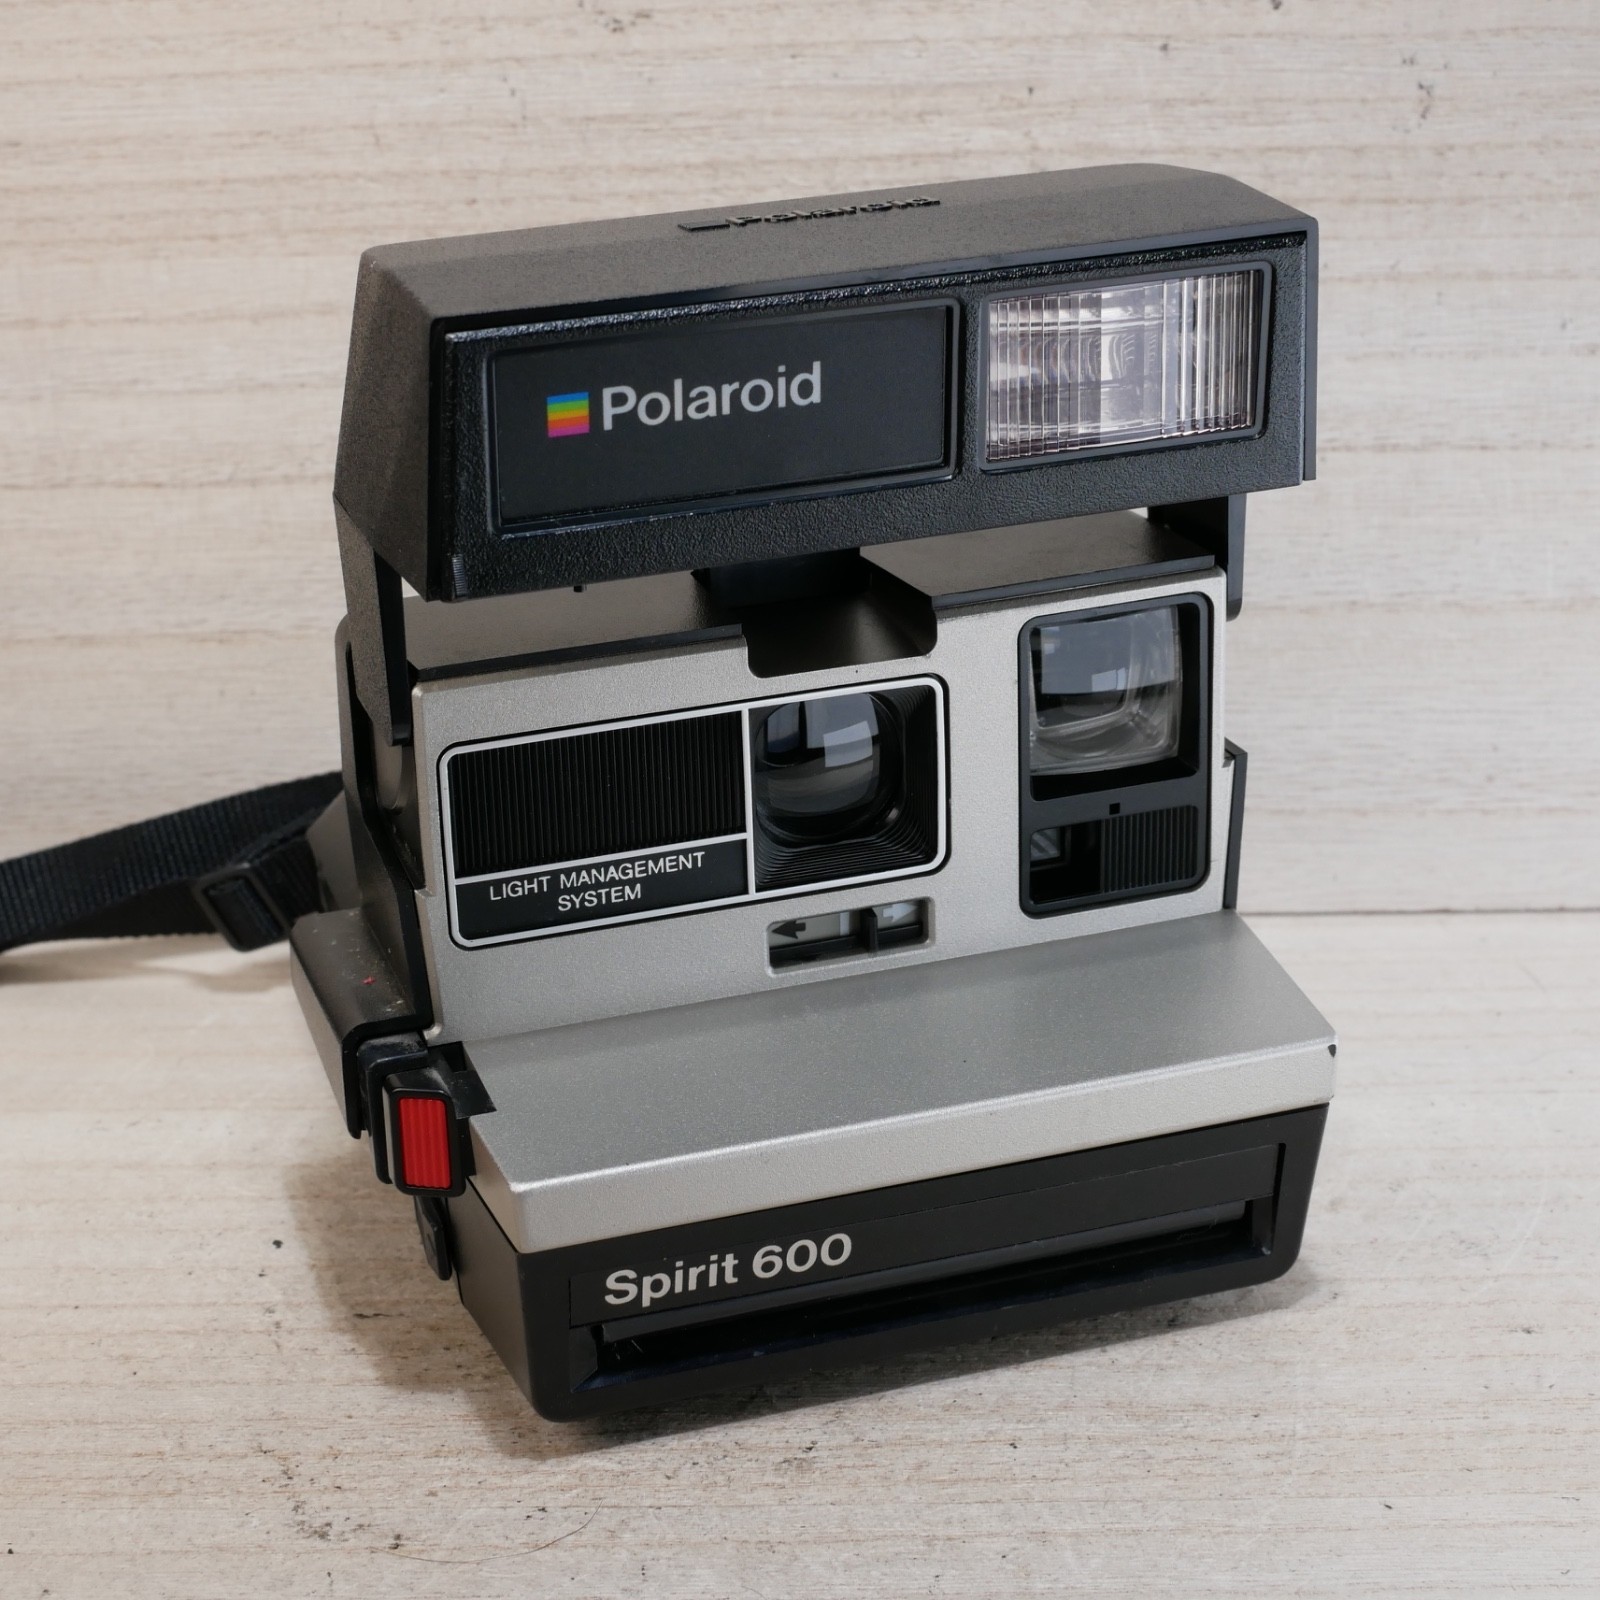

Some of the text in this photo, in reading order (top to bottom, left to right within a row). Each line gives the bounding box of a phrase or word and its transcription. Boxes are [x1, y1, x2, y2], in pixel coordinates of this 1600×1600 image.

[725, 195, 941, 226] Polaroid
[602, 361, 821, 431] Polaroid
[489, 851, 705, 901] LIGHT MANAGEMENT
[557, 883, 641, 912] SYSTEM
[604, 1232, 852, 1308] Spirit 600
